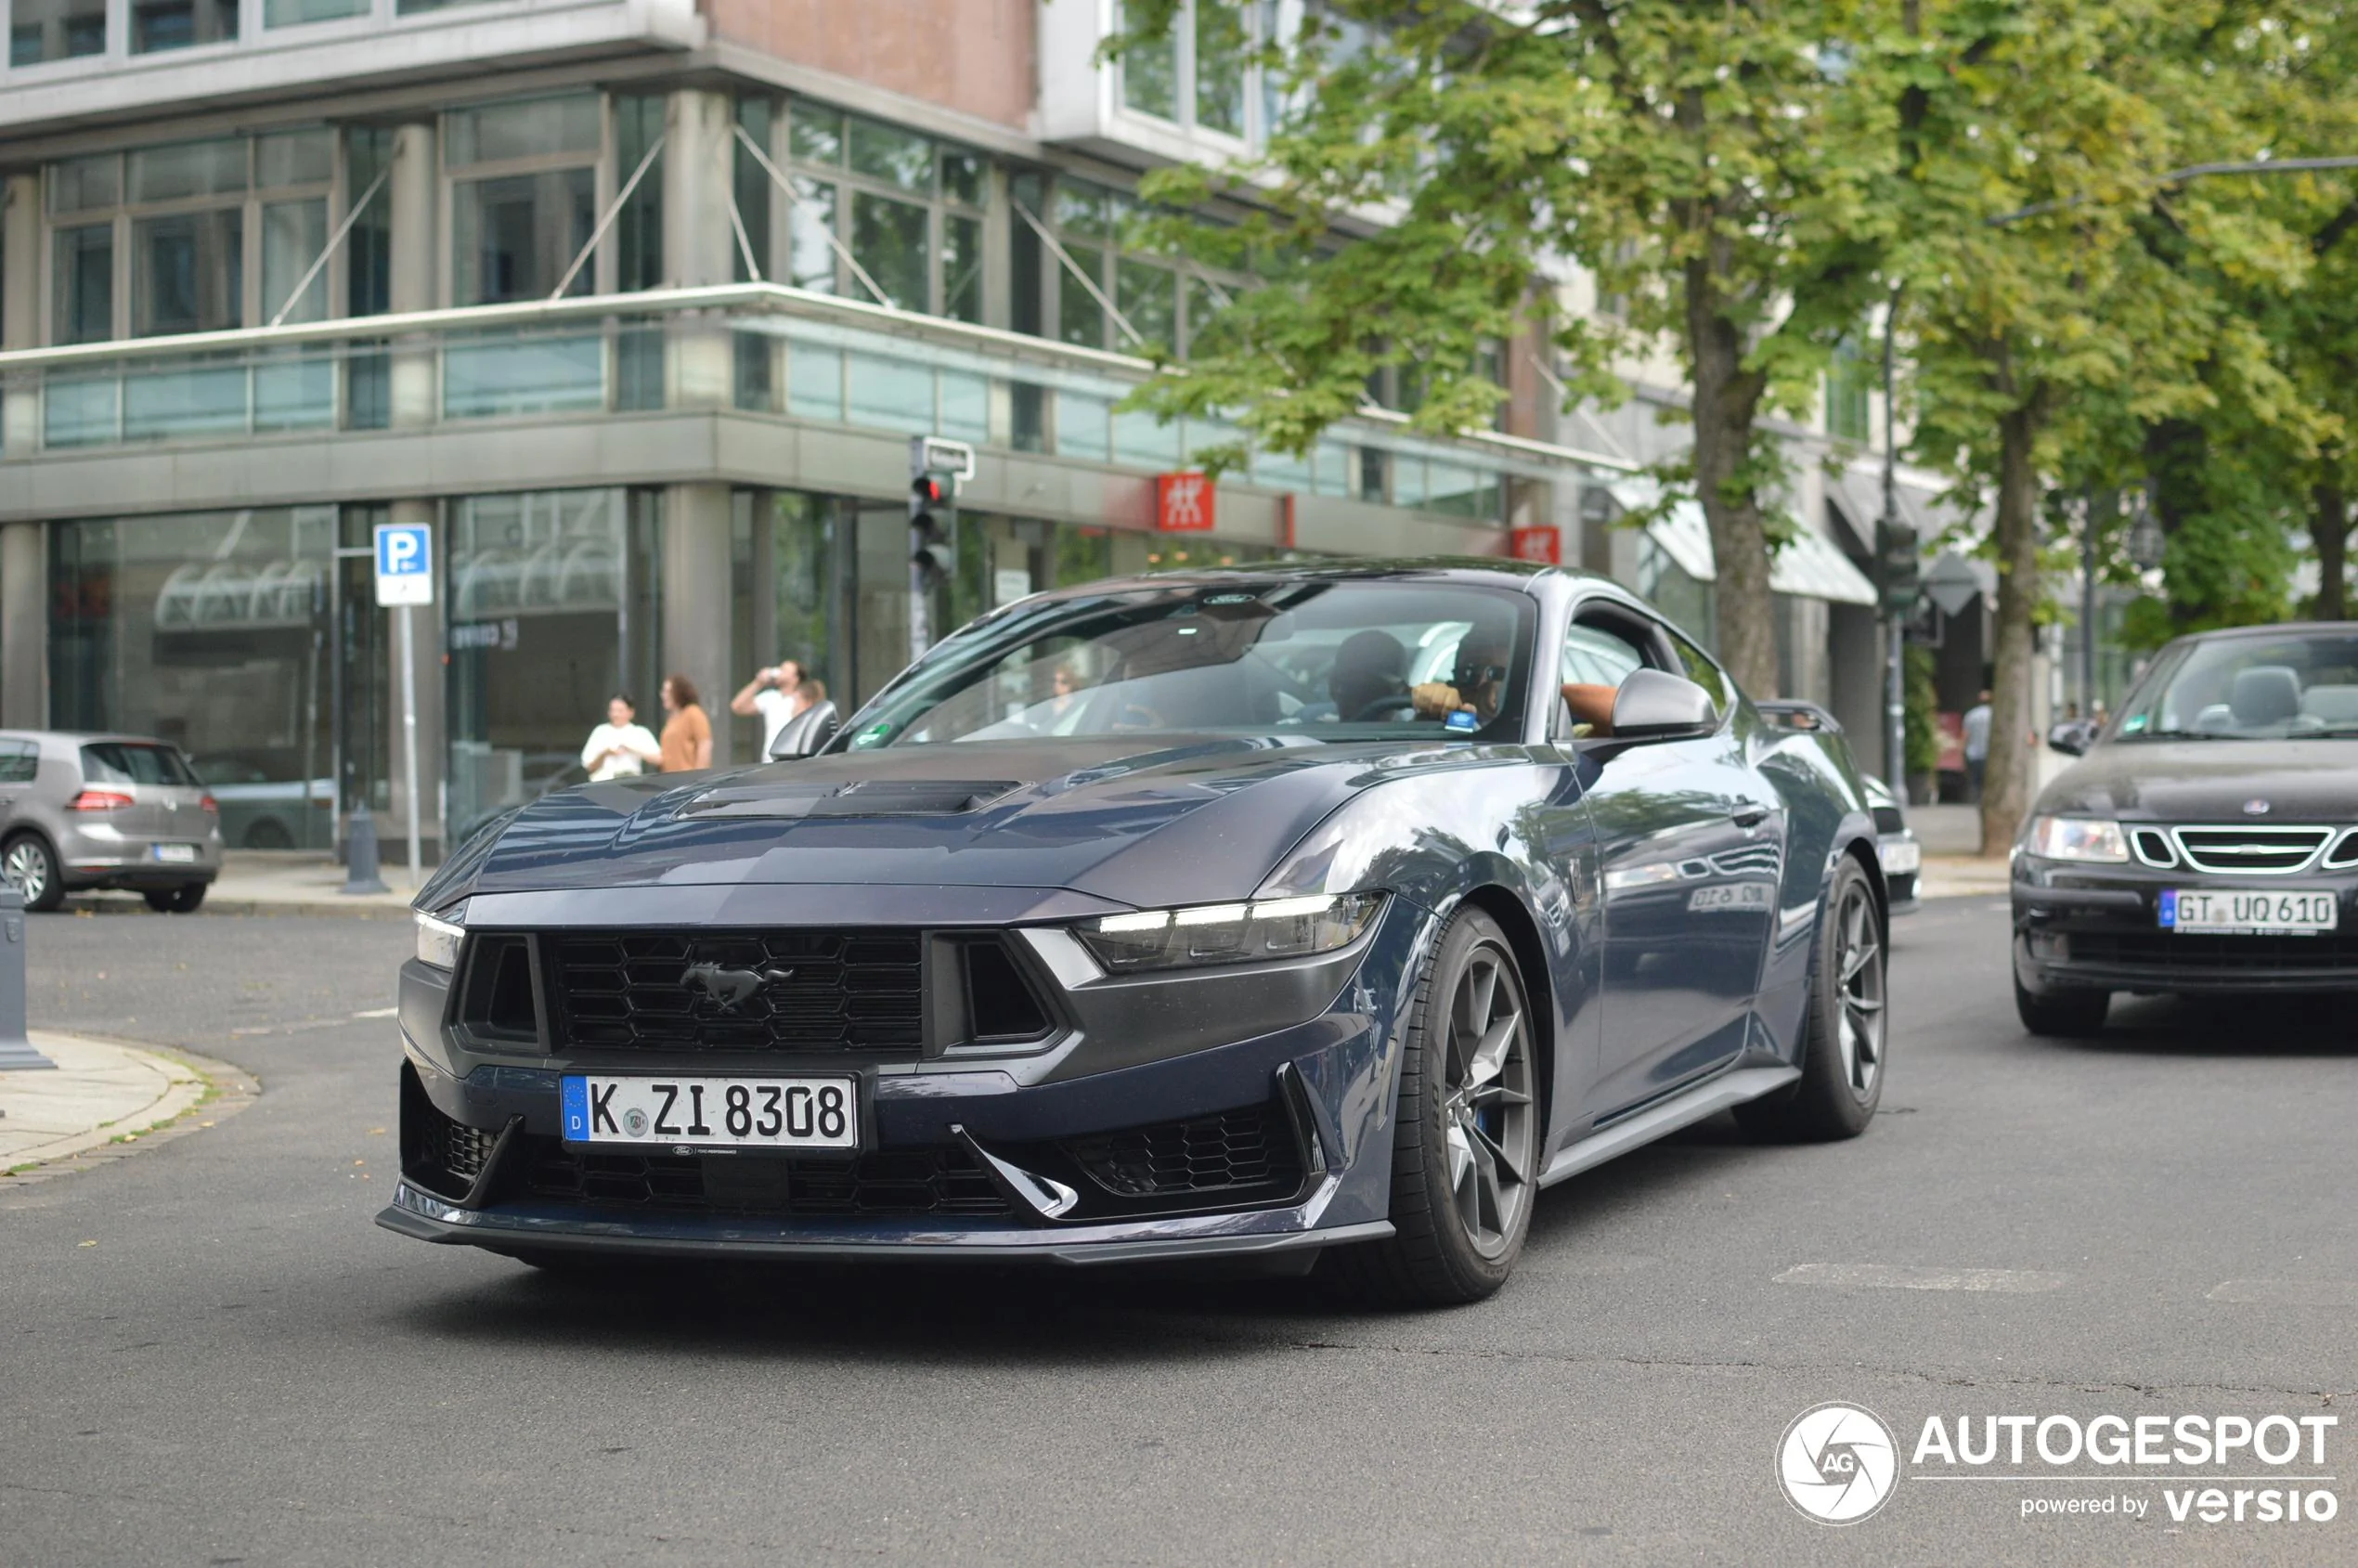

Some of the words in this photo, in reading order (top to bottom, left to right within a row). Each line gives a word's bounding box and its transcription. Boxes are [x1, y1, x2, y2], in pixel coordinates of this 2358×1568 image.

[387, 531, 418, 573] P
[2178, 896, 2212, 922] GT
[2234, 897, 2271, 923] UQ
[2277, 897, 2330, 923] 610
[571, 1116, 581, 1130] D
[590, 1083, 620, 1134] K
[652, 1084, 710, 1135] ZI
[725, 1085, 846, 1138] 8308
